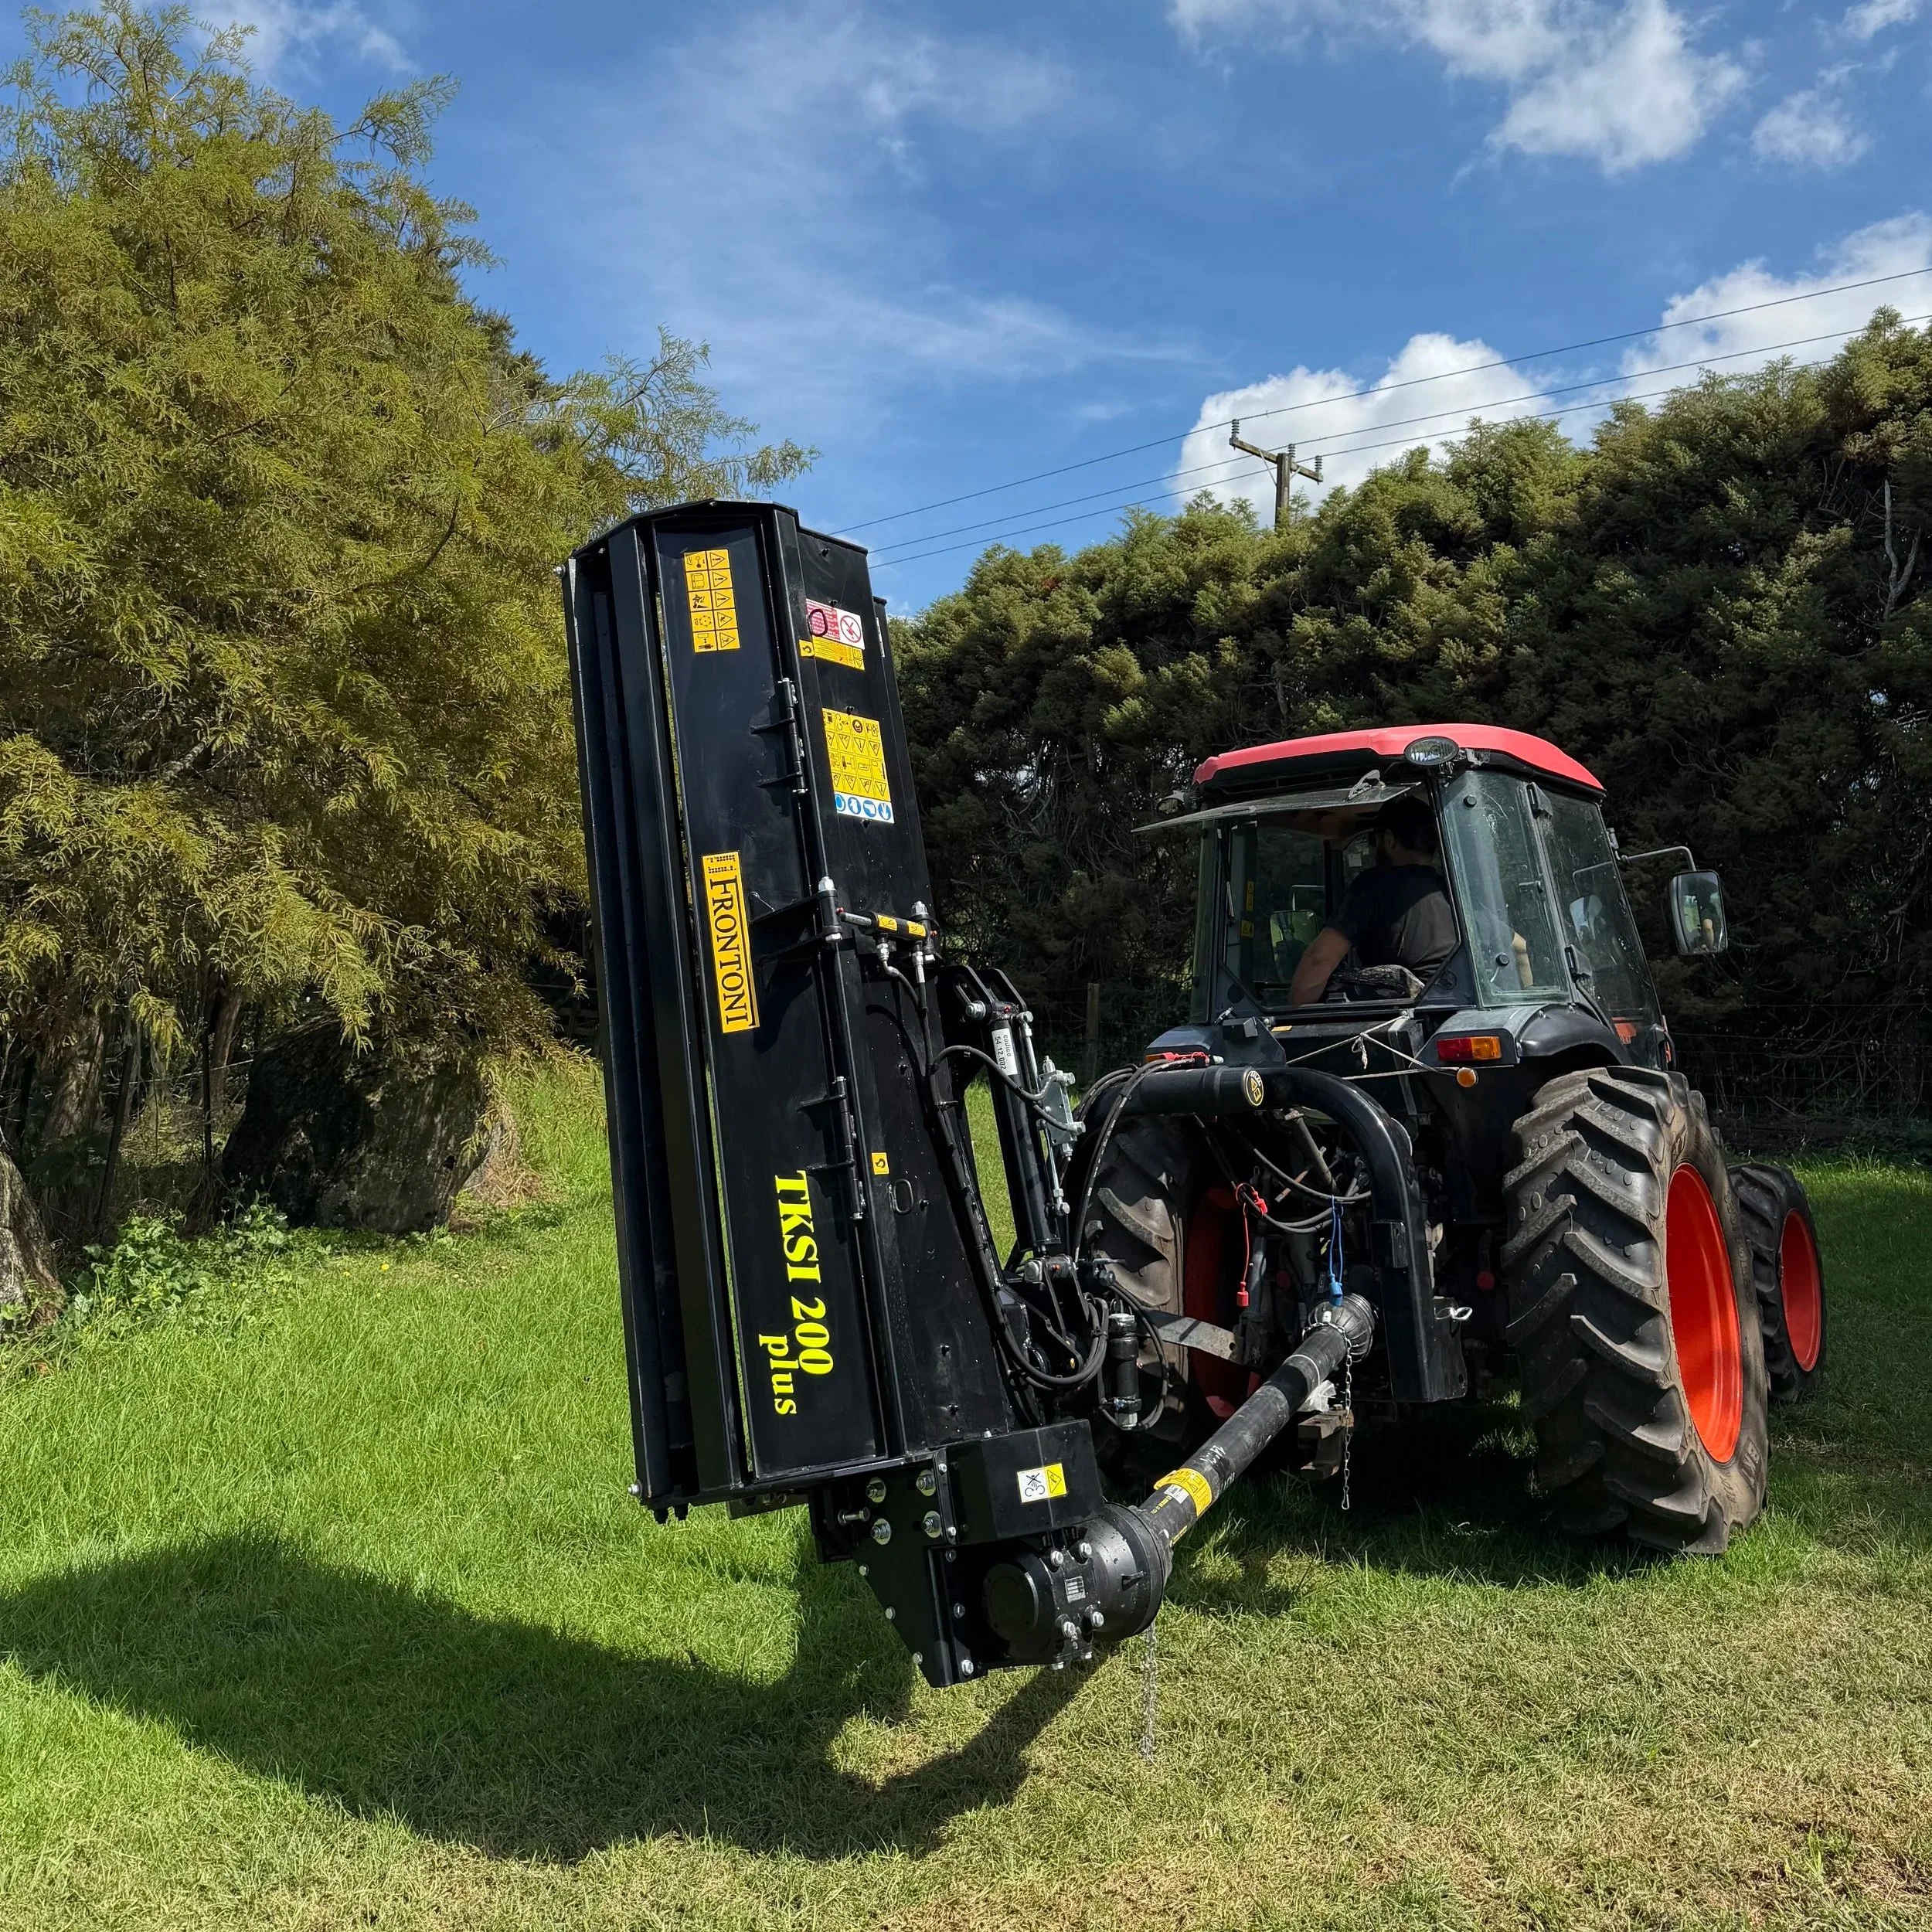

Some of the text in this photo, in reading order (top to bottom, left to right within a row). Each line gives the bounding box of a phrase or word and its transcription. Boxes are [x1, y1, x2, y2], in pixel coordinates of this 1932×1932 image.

[709, 876, 751, 1026] FRONTONI
[995, 1036, 1007, 1070] 54.12.002
[774, 1170, 834, 1375] TKSI 200
[758, 1333, 799, 1416] plus
